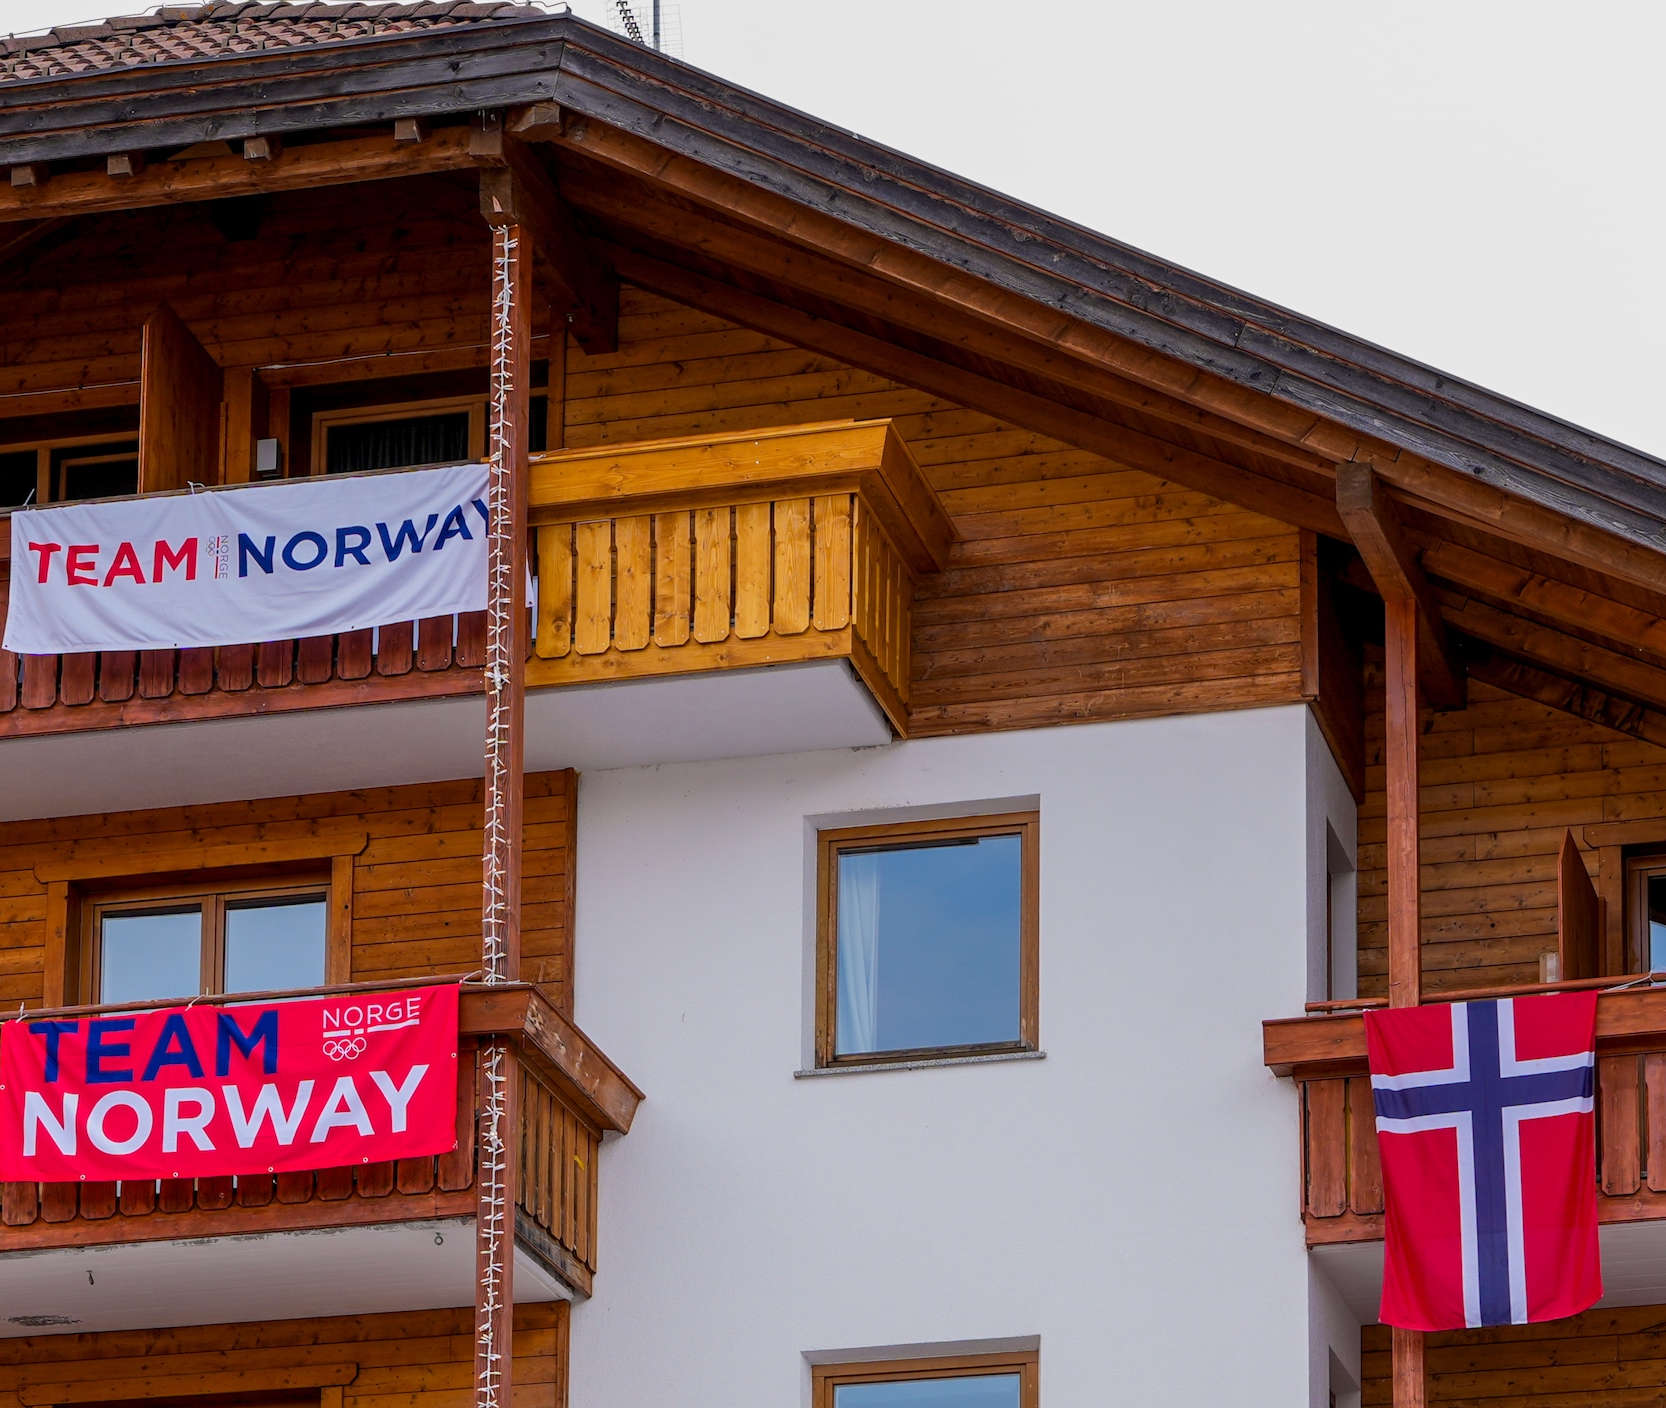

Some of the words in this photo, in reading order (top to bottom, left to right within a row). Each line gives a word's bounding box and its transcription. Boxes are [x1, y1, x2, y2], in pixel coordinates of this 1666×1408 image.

[28, 537, 199, 588] TEAM
[219, 534, 229, 580] NORGE
[322, 996, 422, 1030] NORGE
[28, 1009, 279, 1085] TEAM
[22, 1063, 431, 1158] NORWAY
